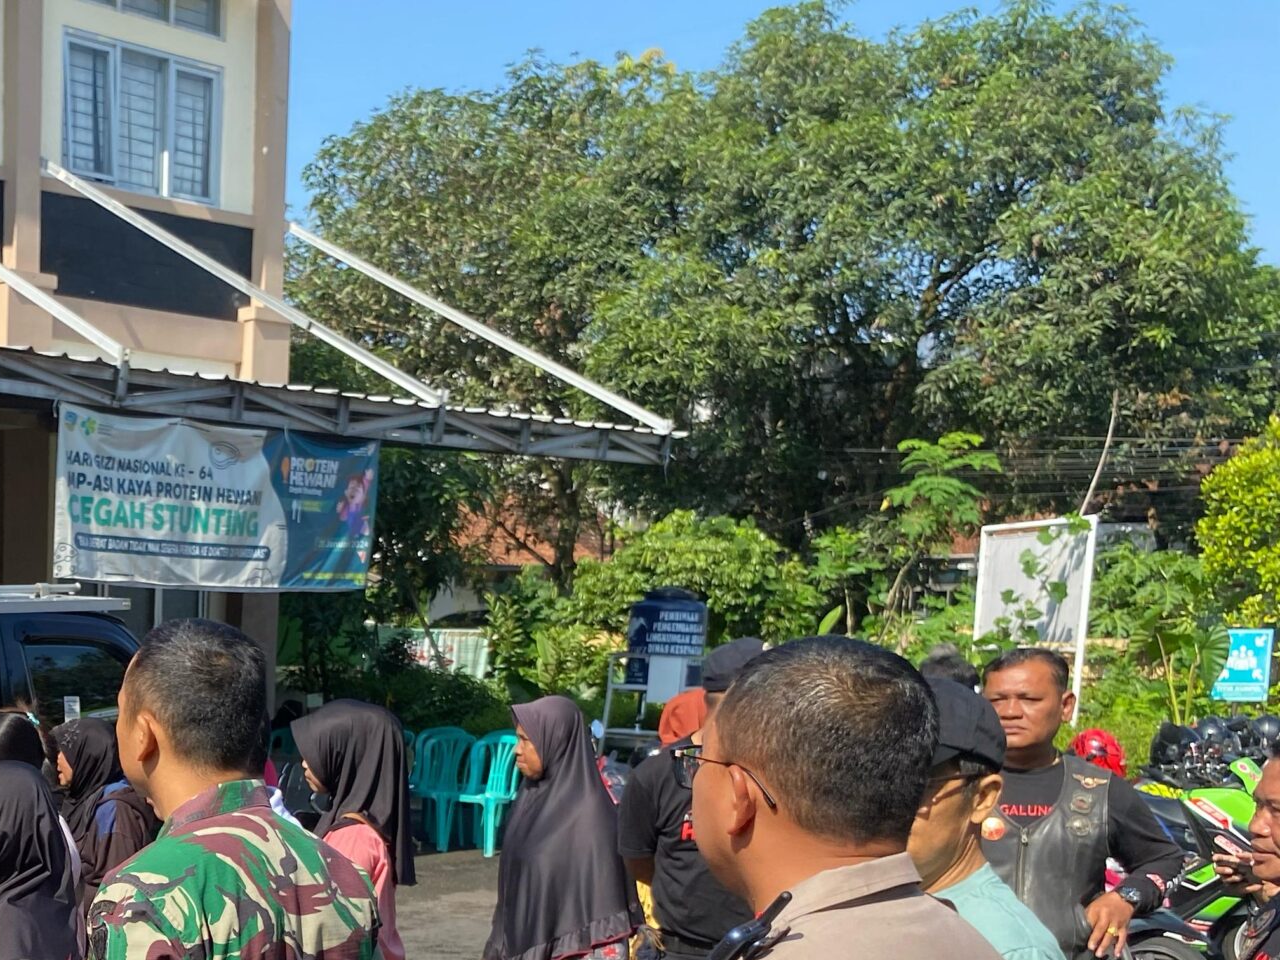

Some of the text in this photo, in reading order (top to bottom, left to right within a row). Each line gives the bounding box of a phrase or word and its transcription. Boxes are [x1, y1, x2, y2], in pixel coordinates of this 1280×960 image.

[94, 454, 116, 471] GIZI
[117, 457, 171, 477] NASIONAL
[290, 456, 340, 474] PROTEIN
[289, 471, 338, 489] HEWANI
[117, 477, 152, 497] KAYA
[156, 481, 212, 503] PROTEIN
[215, 488, 262, 507] HEWANI
[68, 493, 259, 538] CEGAH STUNTING
